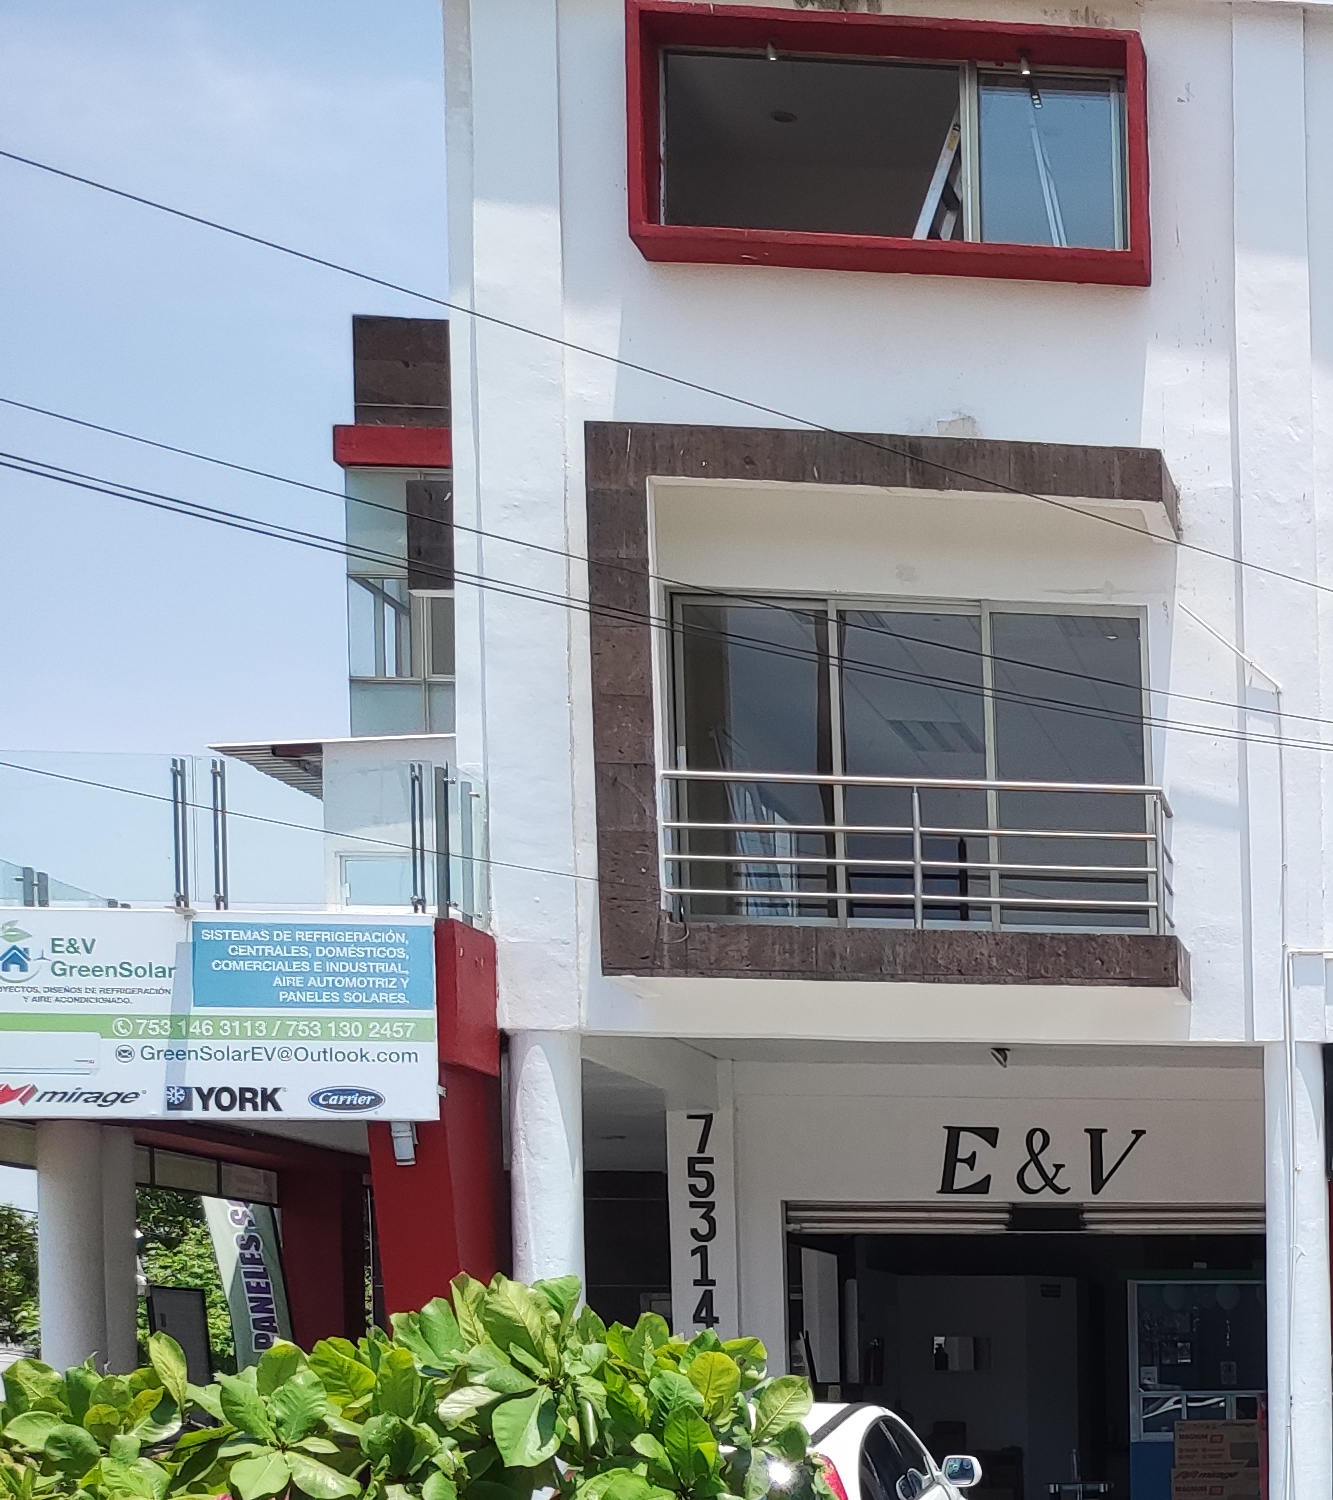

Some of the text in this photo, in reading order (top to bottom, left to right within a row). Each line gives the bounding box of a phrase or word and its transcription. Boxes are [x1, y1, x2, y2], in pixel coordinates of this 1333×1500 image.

[201, 929, 409, 945] SISTEMAS DE REFRIGERACIÓN,
[51, 937, 96, 955] E&V
[228, 945, 312, 958] CENTRALES,
[51, 961, 176, 979] GreenSolar
[211, 960, 409, 974] COMERCIALES E INDUSTRIAL,
[273, 977, 409, 988] AIRE AUTOMOTRIZ Y
[279, 991, 409, 1003] PANELES SOLARES.
[136, 1019, 171, 1036] 753
[177, 1020, 213, 1036] 146
[219, 1020, 267, 1036] 3113
[286, 1021, 322, 1037] 753
[327, 1021, 363, 1037] 130
[369, 1022, 416, 1038] 2457
[140, 1045, 418, 1063] GreenSolarEV@Outlook.com
[35, 1087, 140, 1107] mirage
[195, 1086, 284, 1112] YORK
[318, 1091, 376, 1106] Carrier
